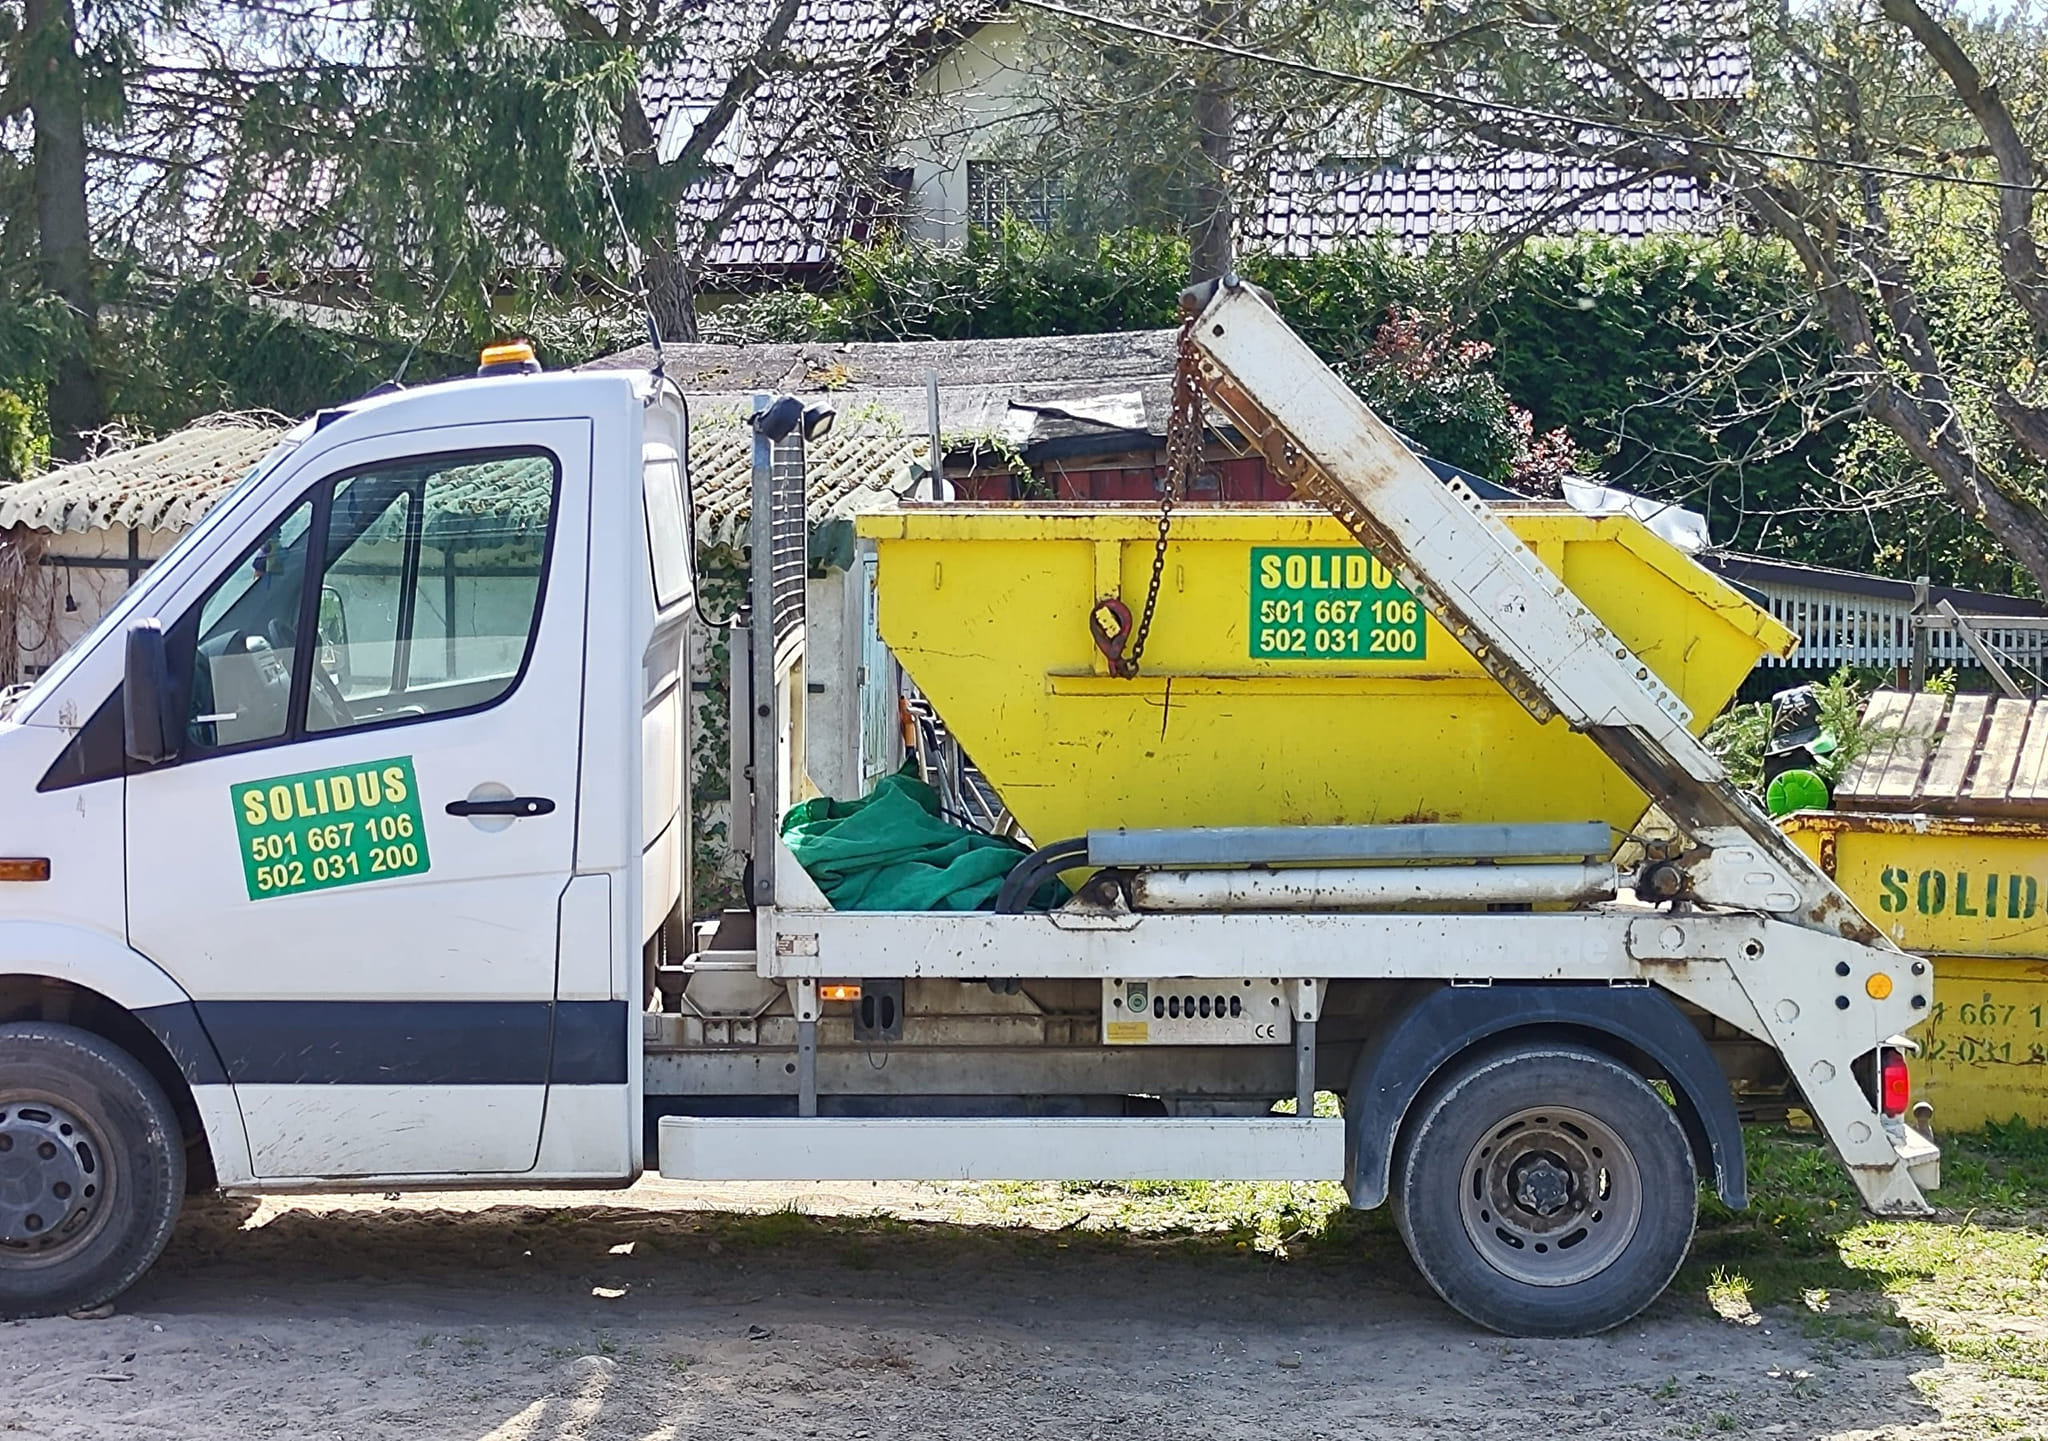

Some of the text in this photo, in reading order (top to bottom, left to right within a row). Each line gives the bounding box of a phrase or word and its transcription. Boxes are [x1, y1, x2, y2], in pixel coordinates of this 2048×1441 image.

[1260, 554, 1406, 590] SOLIDU
[1260, 600, 1417, 624] 501 667 106
[1260, 629, 1417, 652] 502 031 200
[243, 766, 407, 826] SOLIDUS
[252, 813, 413, 861] 501 667 106
[257, 843, 418, 891] 502 031 200
[1879, 867, 2048, 919] SOLID
[1960, 1003, 2015, 1026] 667
